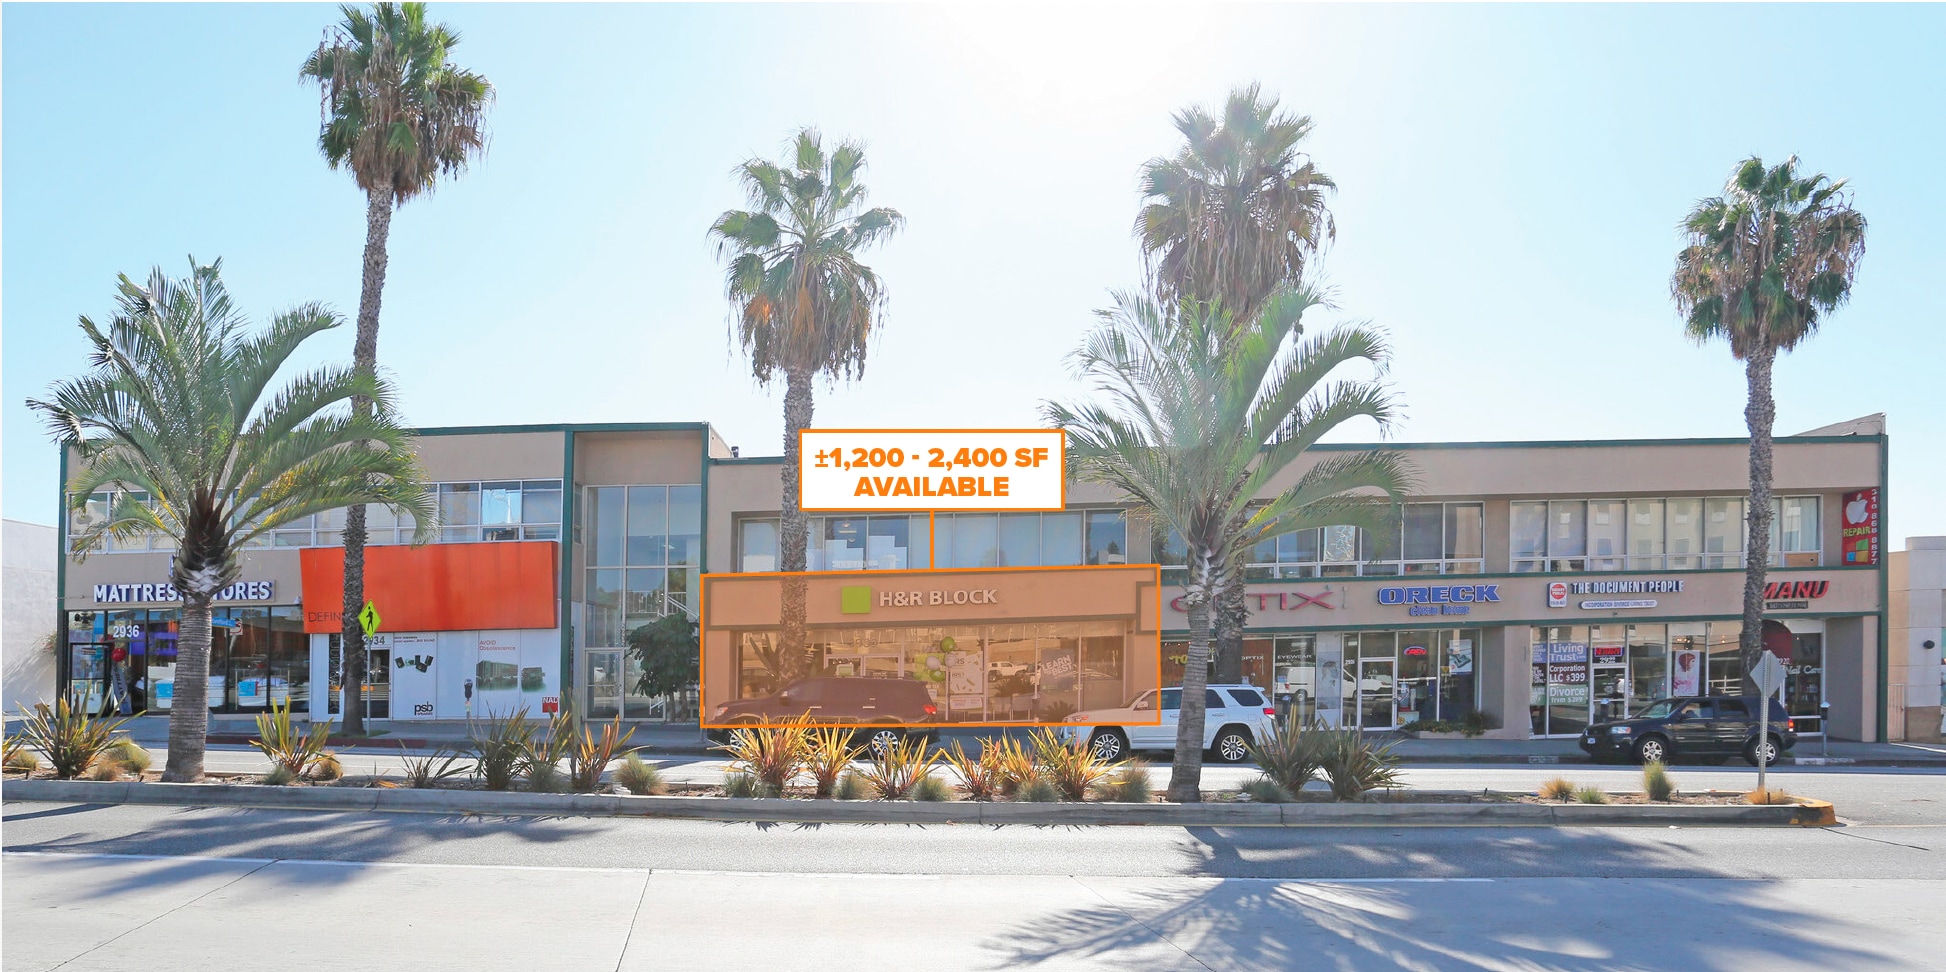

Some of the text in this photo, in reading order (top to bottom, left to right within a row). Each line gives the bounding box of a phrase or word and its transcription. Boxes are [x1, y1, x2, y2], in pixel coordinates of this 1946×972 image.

[1843, 526, 1871, 537] REPAIR
[93, 581, 272, 603] MATTRES ORES
[1572, 580, 1684, 594] THE DOCUMENT PEOPLE
[879, 589, 998, 607] H&R BLOCK
[1378, 585, 1503, 605] ORECK
[308, 612, 342, 622] DEFIN
[113, 625, 140, 638] 2936
[1553, 643, 1584, 655] Living
[1549, 653, 1577, 661] Trust
[1549, 664, 1586, 673] Corporation
[1549, 673, 1564, 683] LLC
[1565, 672, 1586, 682] $399
[1549, 687, 1585, 697] Divorce
[414, 701, 433, 715] psb
